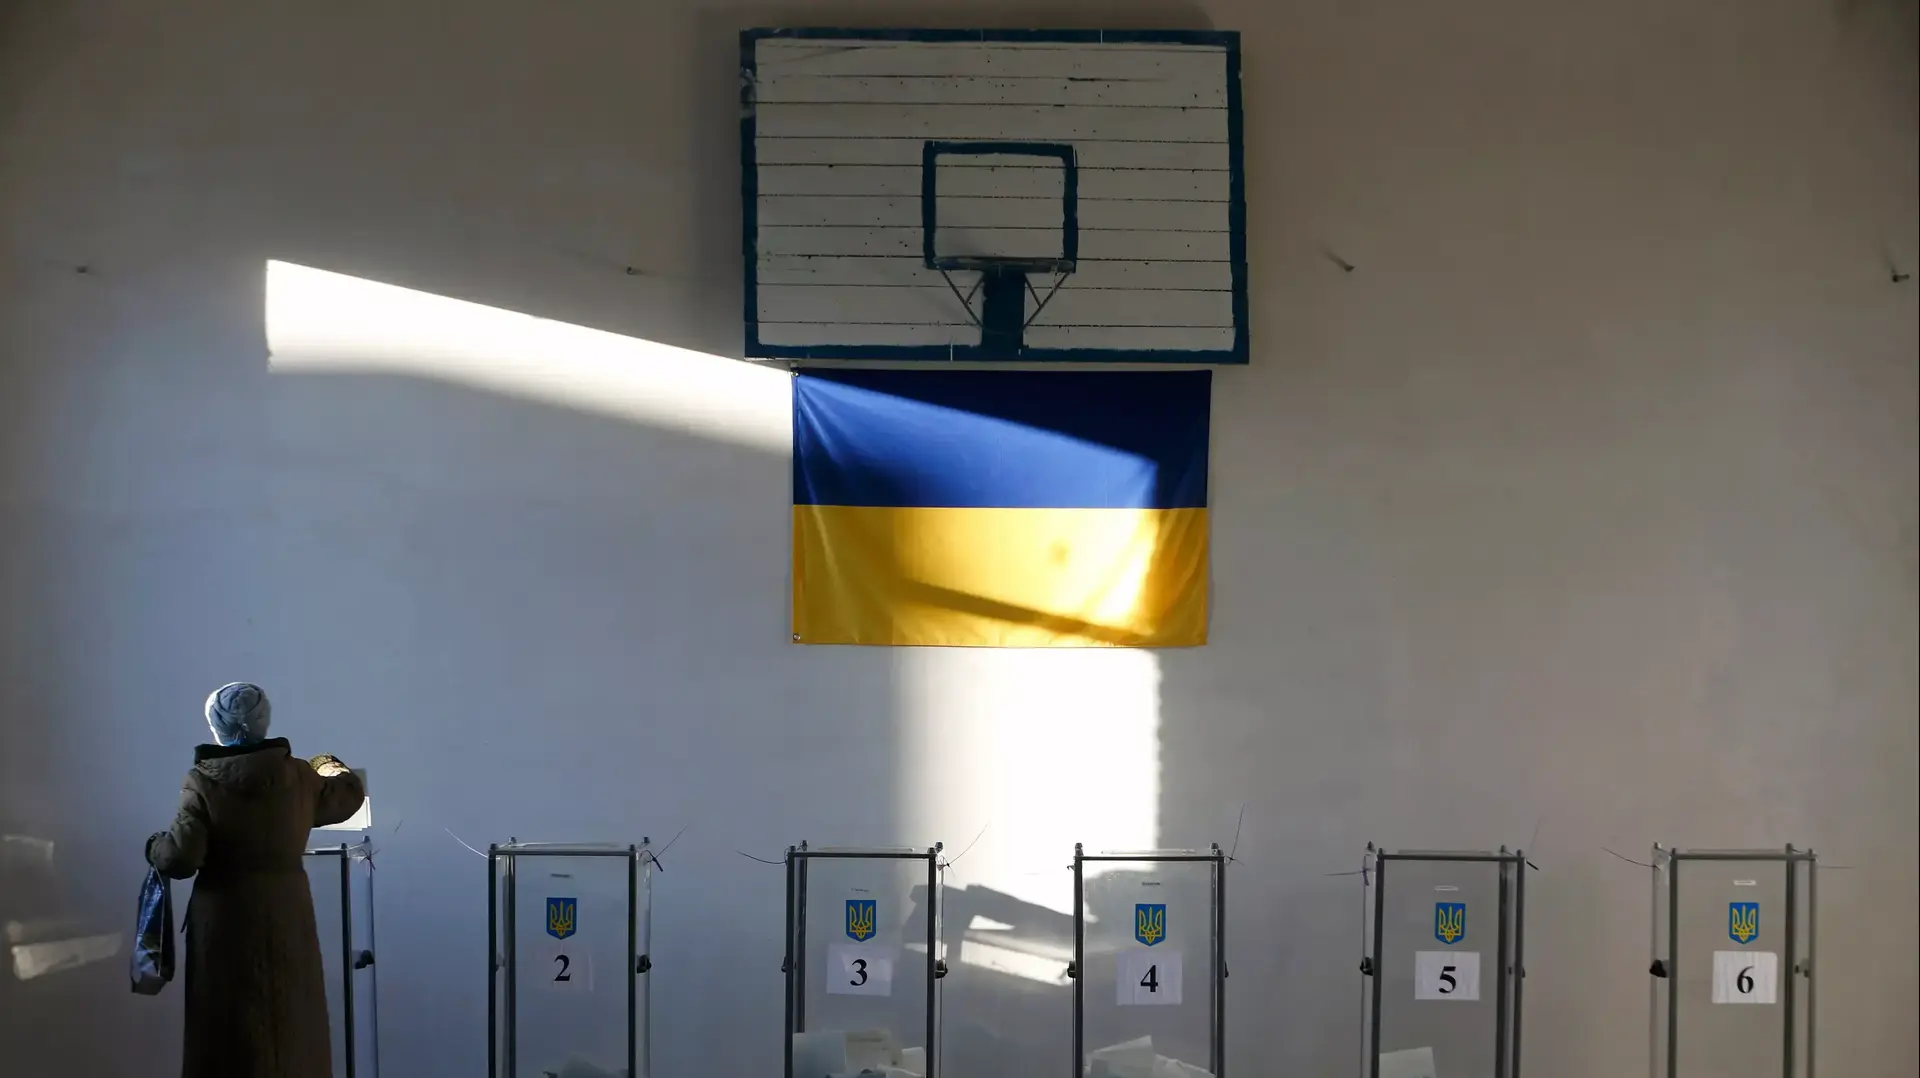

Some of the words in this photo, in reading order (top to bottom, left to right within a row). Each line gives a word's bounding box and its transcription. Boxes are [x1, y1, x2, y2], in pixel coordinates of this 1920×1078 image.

[554, 954, 571, 982] 2
[850, 958, 868, 987] 3
[1140, 964, 1158, 993] 4
[1438, 965, 1457, 994] 5
[1736, 966, 1754, 994] 6
